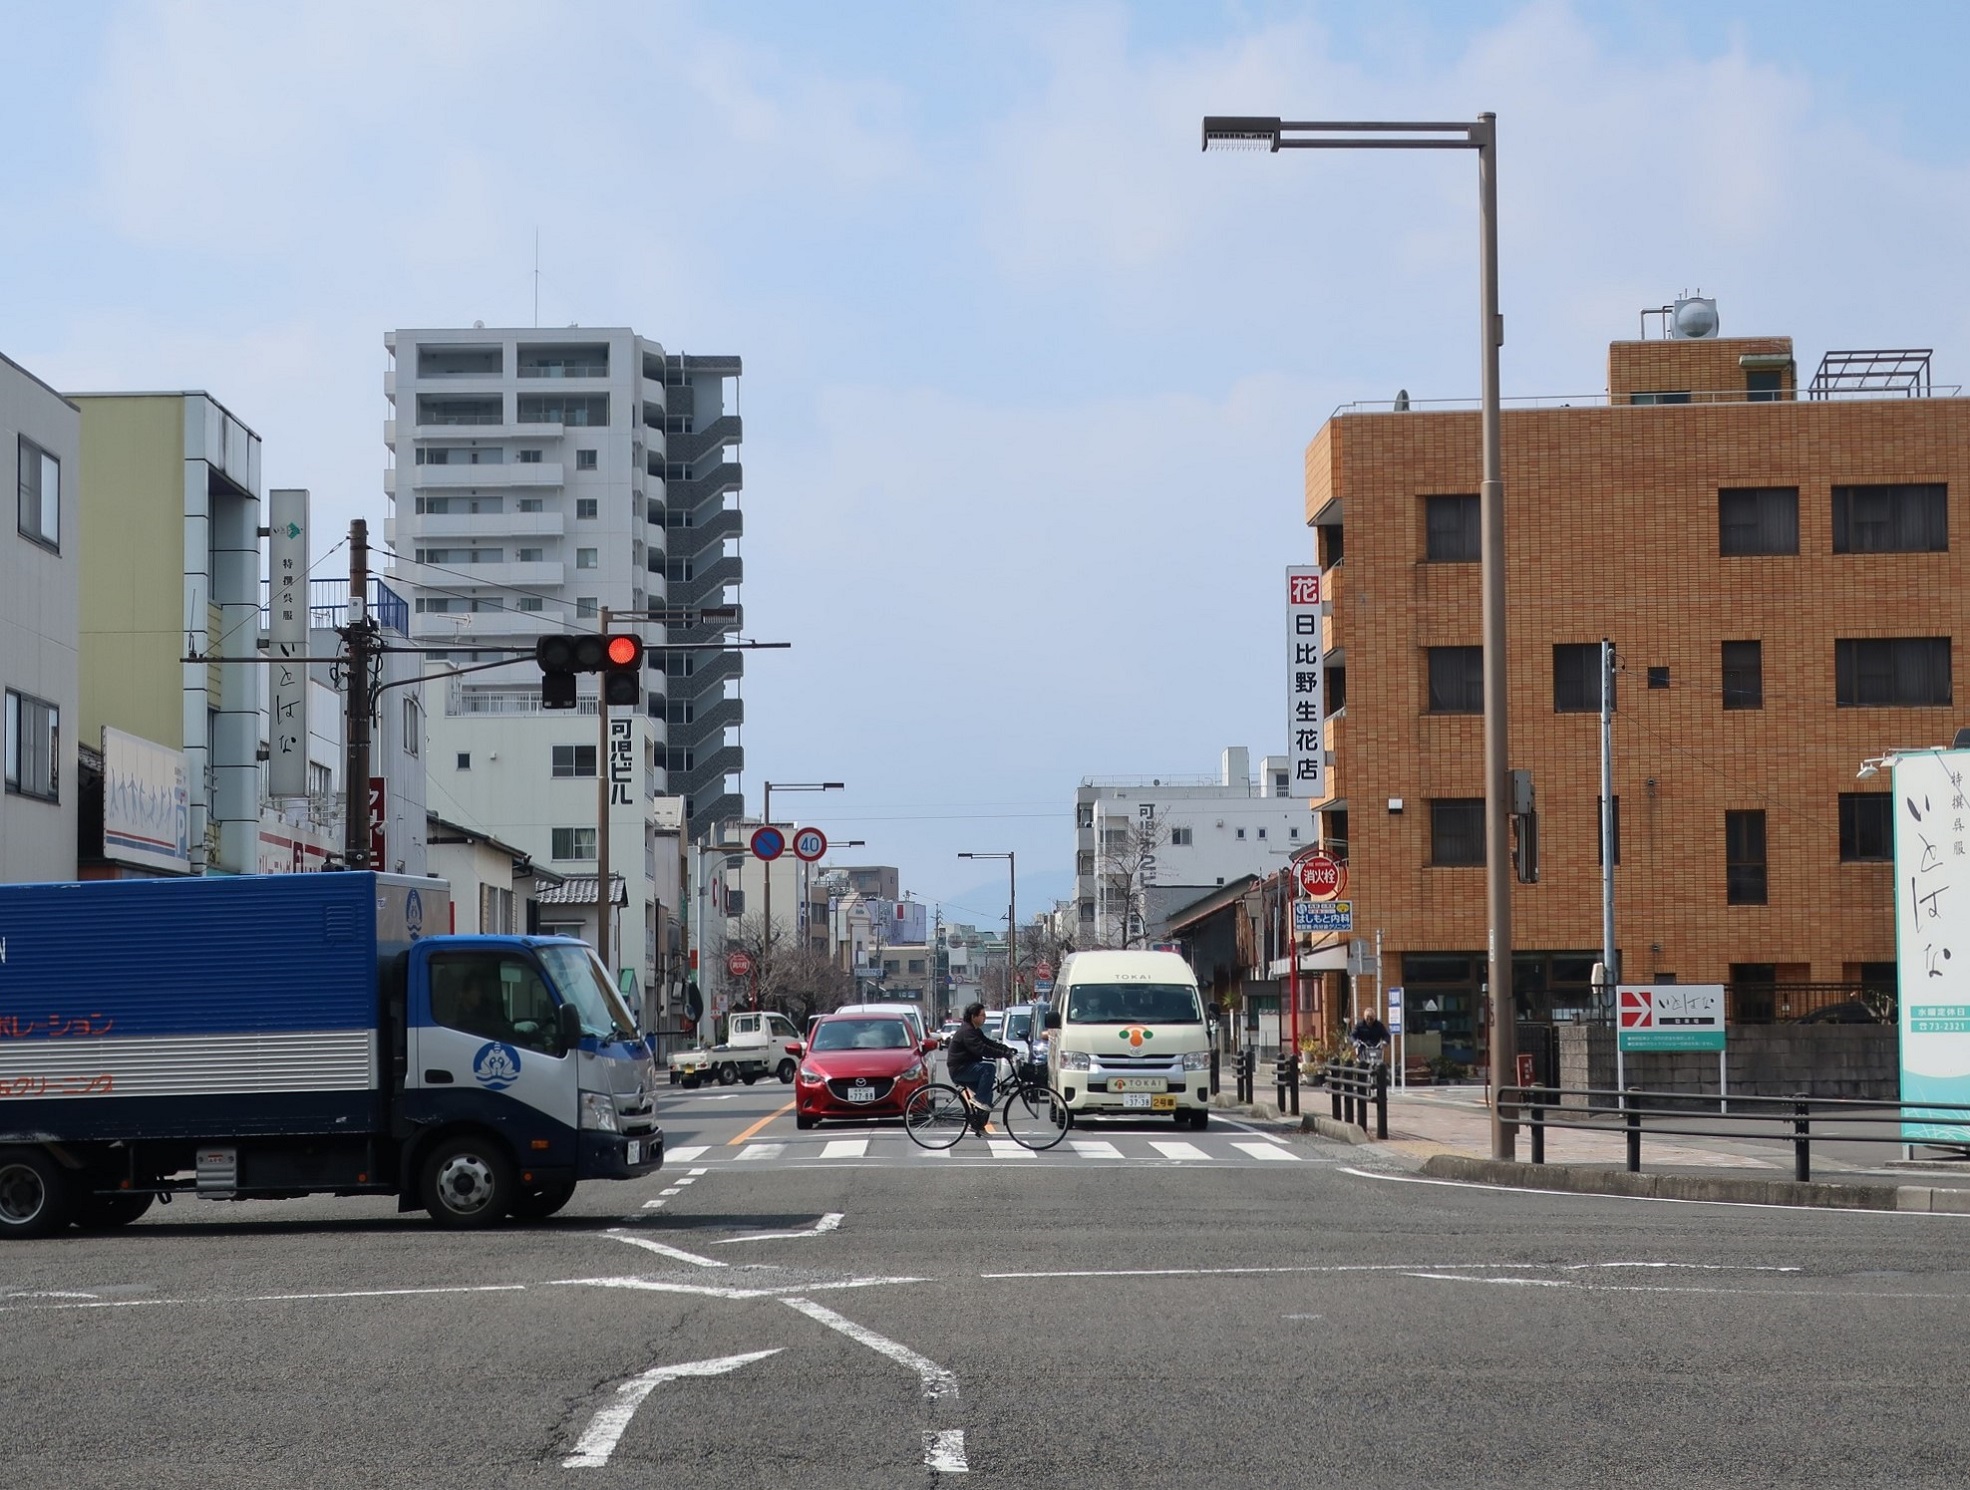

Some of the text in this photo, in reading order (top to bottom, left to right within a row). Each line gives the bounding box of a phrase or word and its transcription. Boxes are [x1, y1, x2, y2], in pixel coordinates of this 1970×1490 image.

[282, 558, 293, 621] 特撰呉服
[1292, 578, 1317, 602] 花
[1295, 614, 1318, 780] 日比野生花店
[610, 719, 633, 804] 可児ビル
[1950, 771, 1966, 855] 特撰呉服
[801, 837, 819, 852] 40
[1303, 868, 1336, 884] 消火栓
[1906, 794, 1950, 978] いとはな
[1296, 914, 1350, 924] はしもと内科
[1658, 993, 1715, 1015] いとはな
